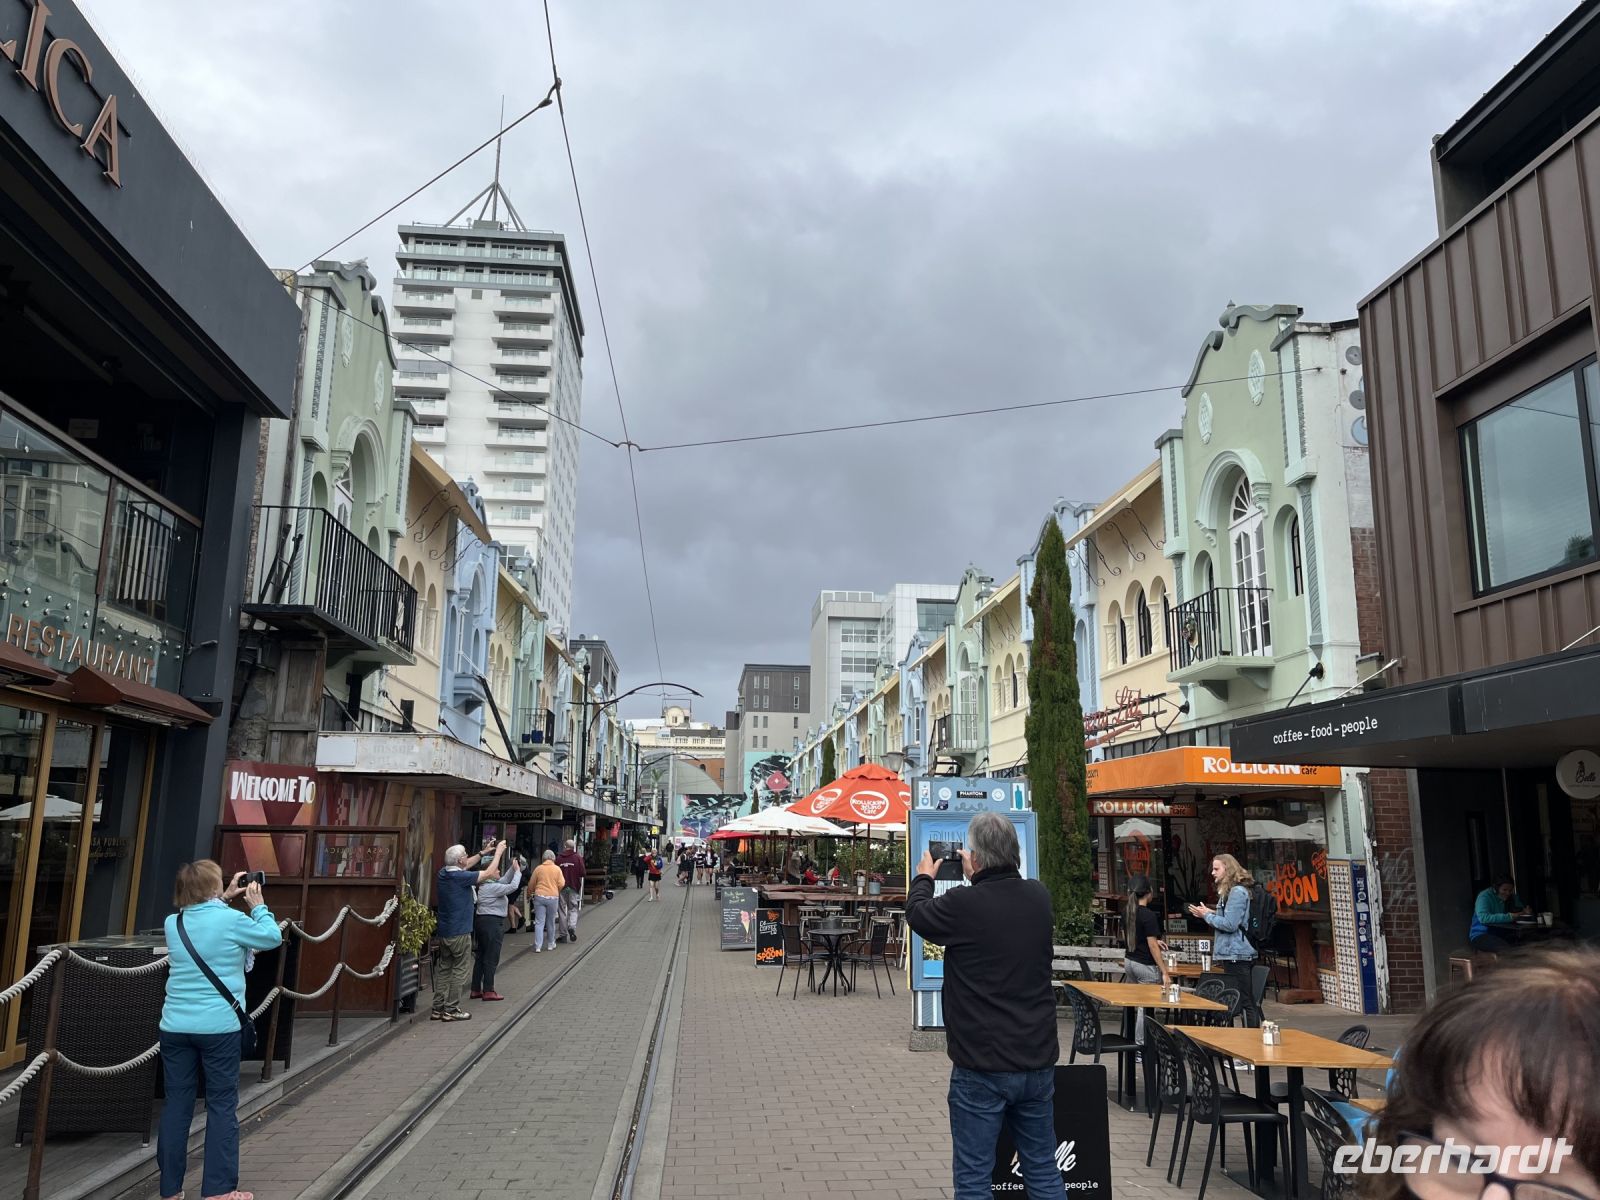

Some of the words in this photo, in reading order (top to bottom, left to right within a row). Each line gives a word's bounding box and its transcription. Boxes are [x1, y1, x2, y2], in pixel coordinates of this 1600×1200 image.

[6, 612, 155, 685] RESTAURANT
[230, 771, 297, 803] WELCOME
[1200, 941, 1209, 950] 38
[1065, 1180, 1099, 1190] people
